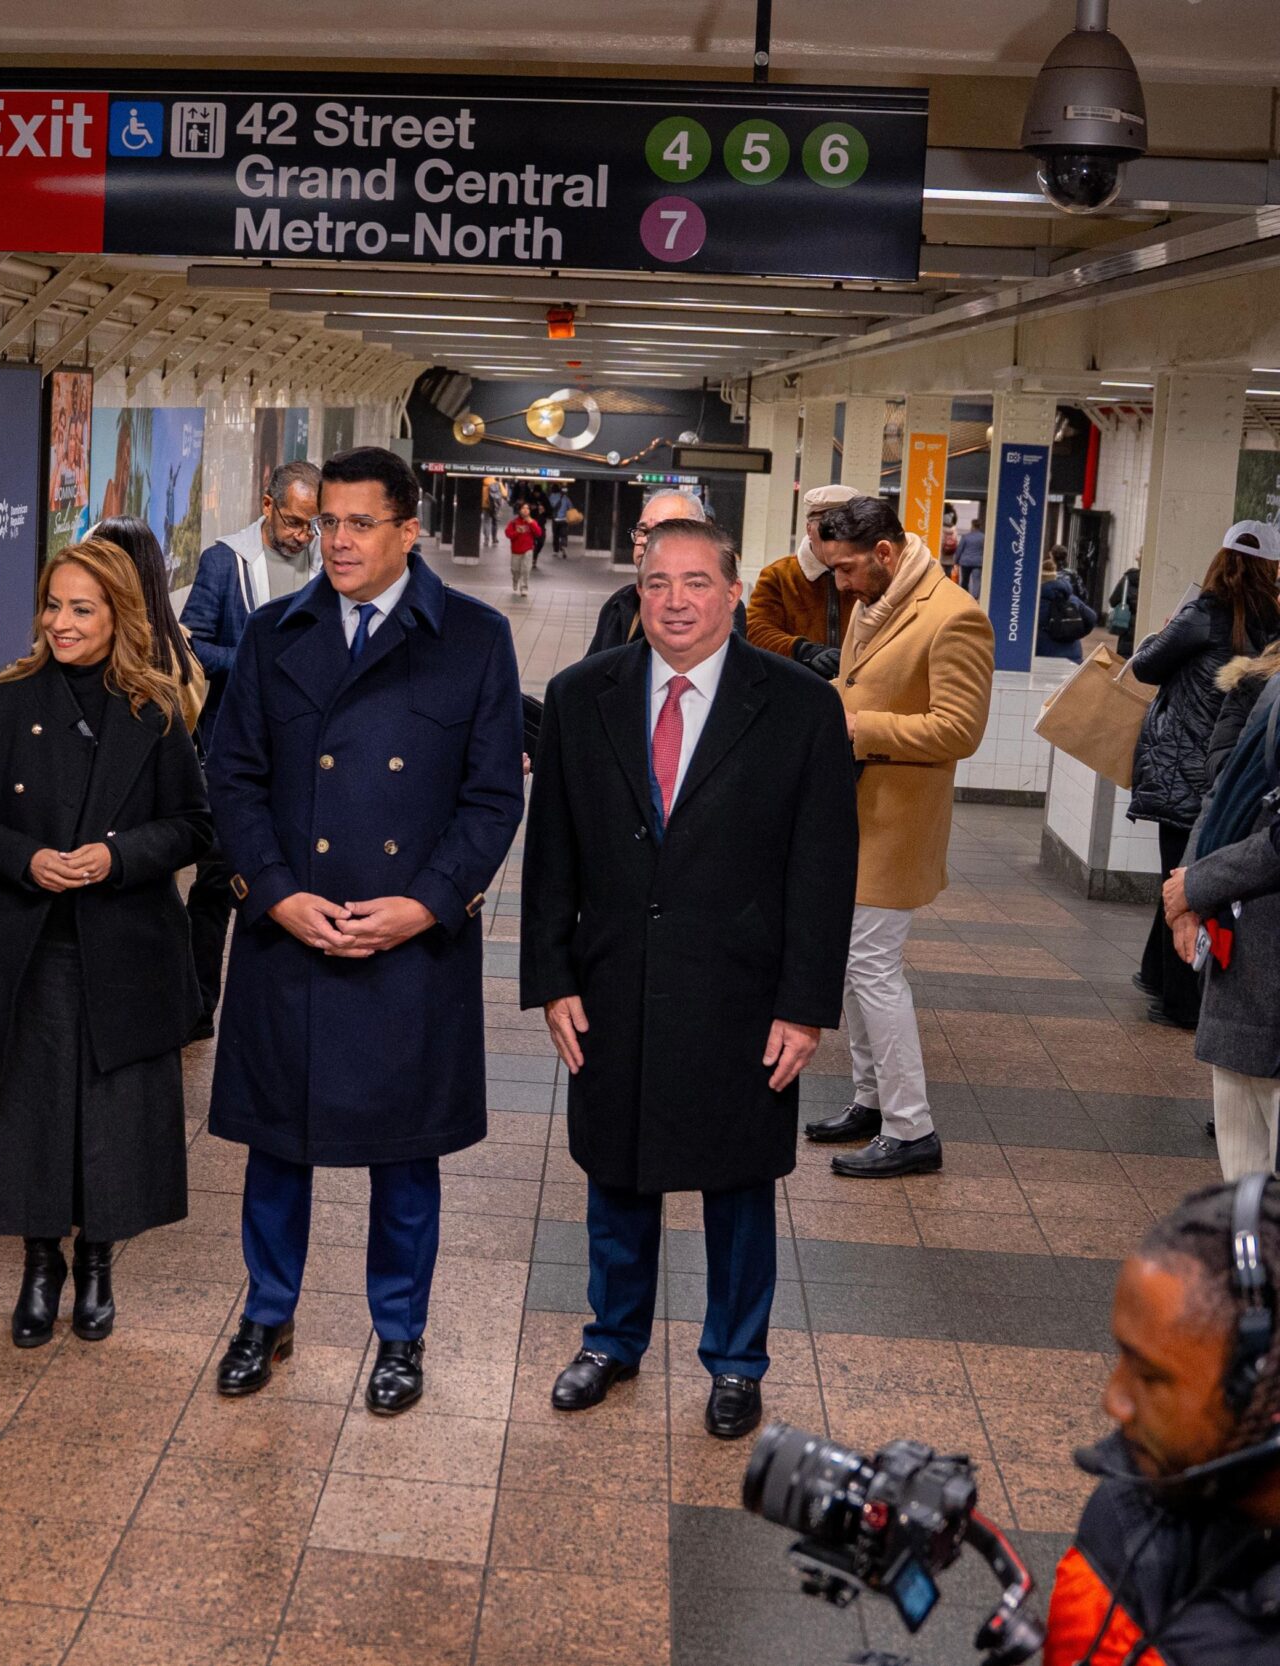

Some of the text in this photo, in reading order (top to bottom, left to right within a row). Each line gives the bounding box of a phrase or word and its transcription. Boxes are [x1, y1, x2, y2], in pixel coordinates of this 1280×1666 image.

[235, 102, 476, 150] 42 Street
[662, 130, 850, 174] 4 5 6
[235, 154, 609, 208] Grand Central
[234, 207, 563, 261] Metro-North
[660, 210, 687, 249] 7
[1016, 495, 1028, 515] at
[1023, 474, 1037, 506] you
[1008, 516, 1028, 558] Smiles
[1008, 558, 1024, 641] DOMINICANA
